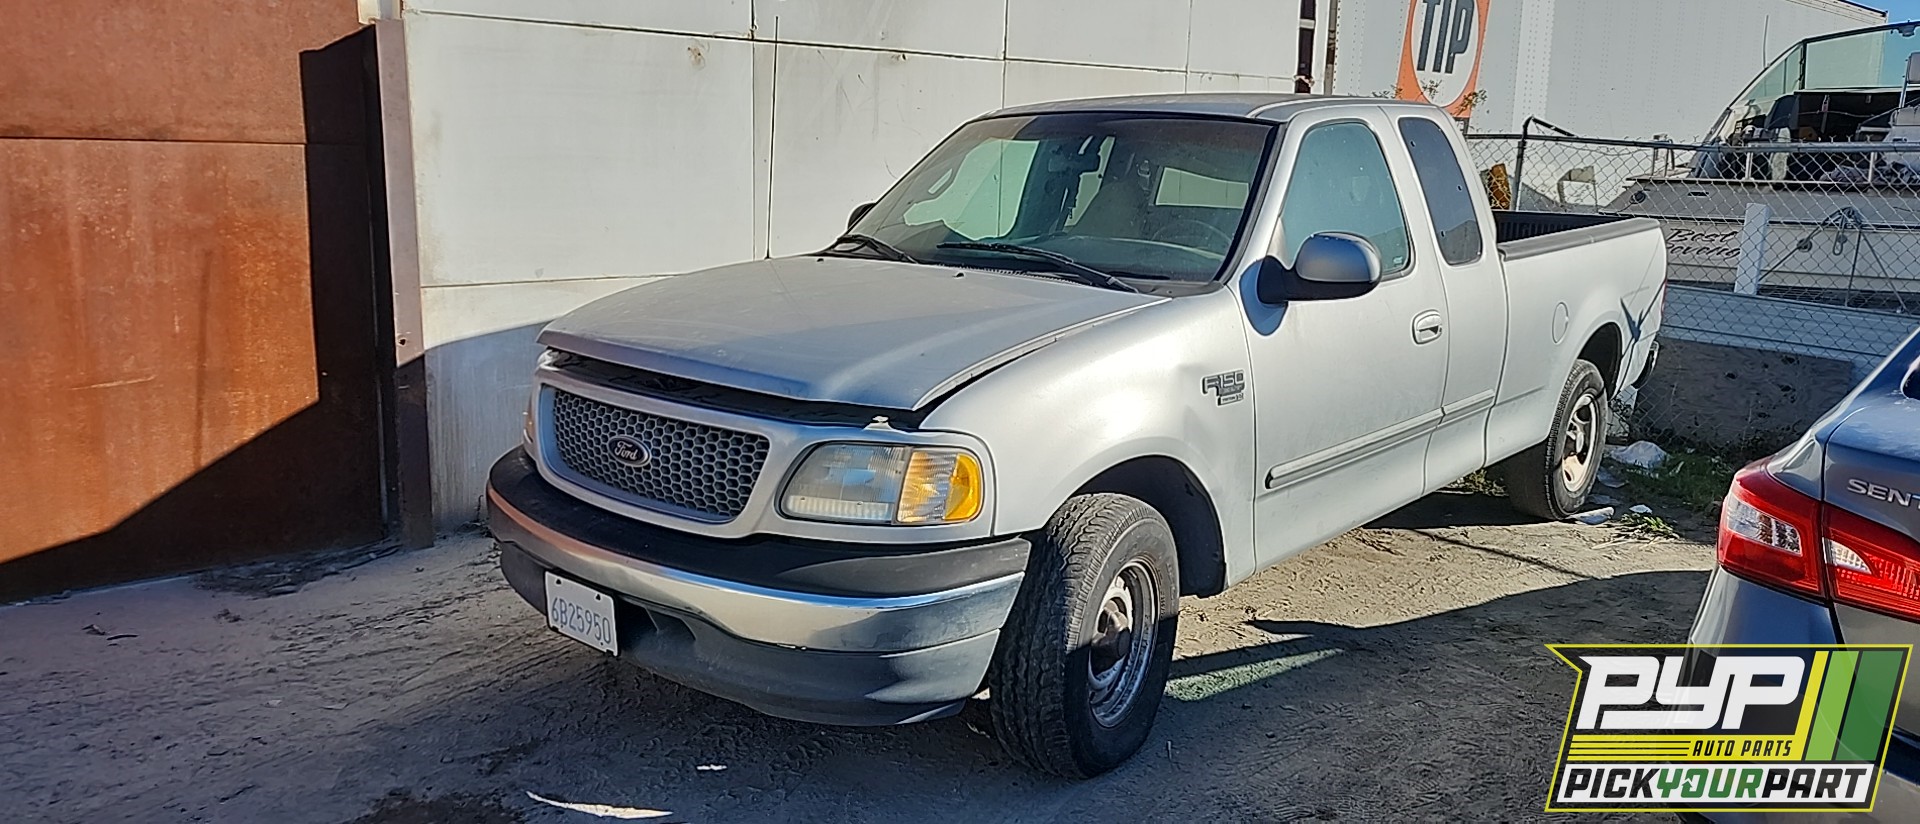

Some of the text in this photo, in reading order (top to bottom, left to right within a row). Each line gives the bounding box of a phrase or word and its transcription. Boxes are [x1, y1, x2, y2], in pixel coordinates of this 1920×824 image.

[1417, 0, 1475, 74] TIP
[614, 440, 639, 461] Ford
[551, 597, 612, 644] 6B25950
